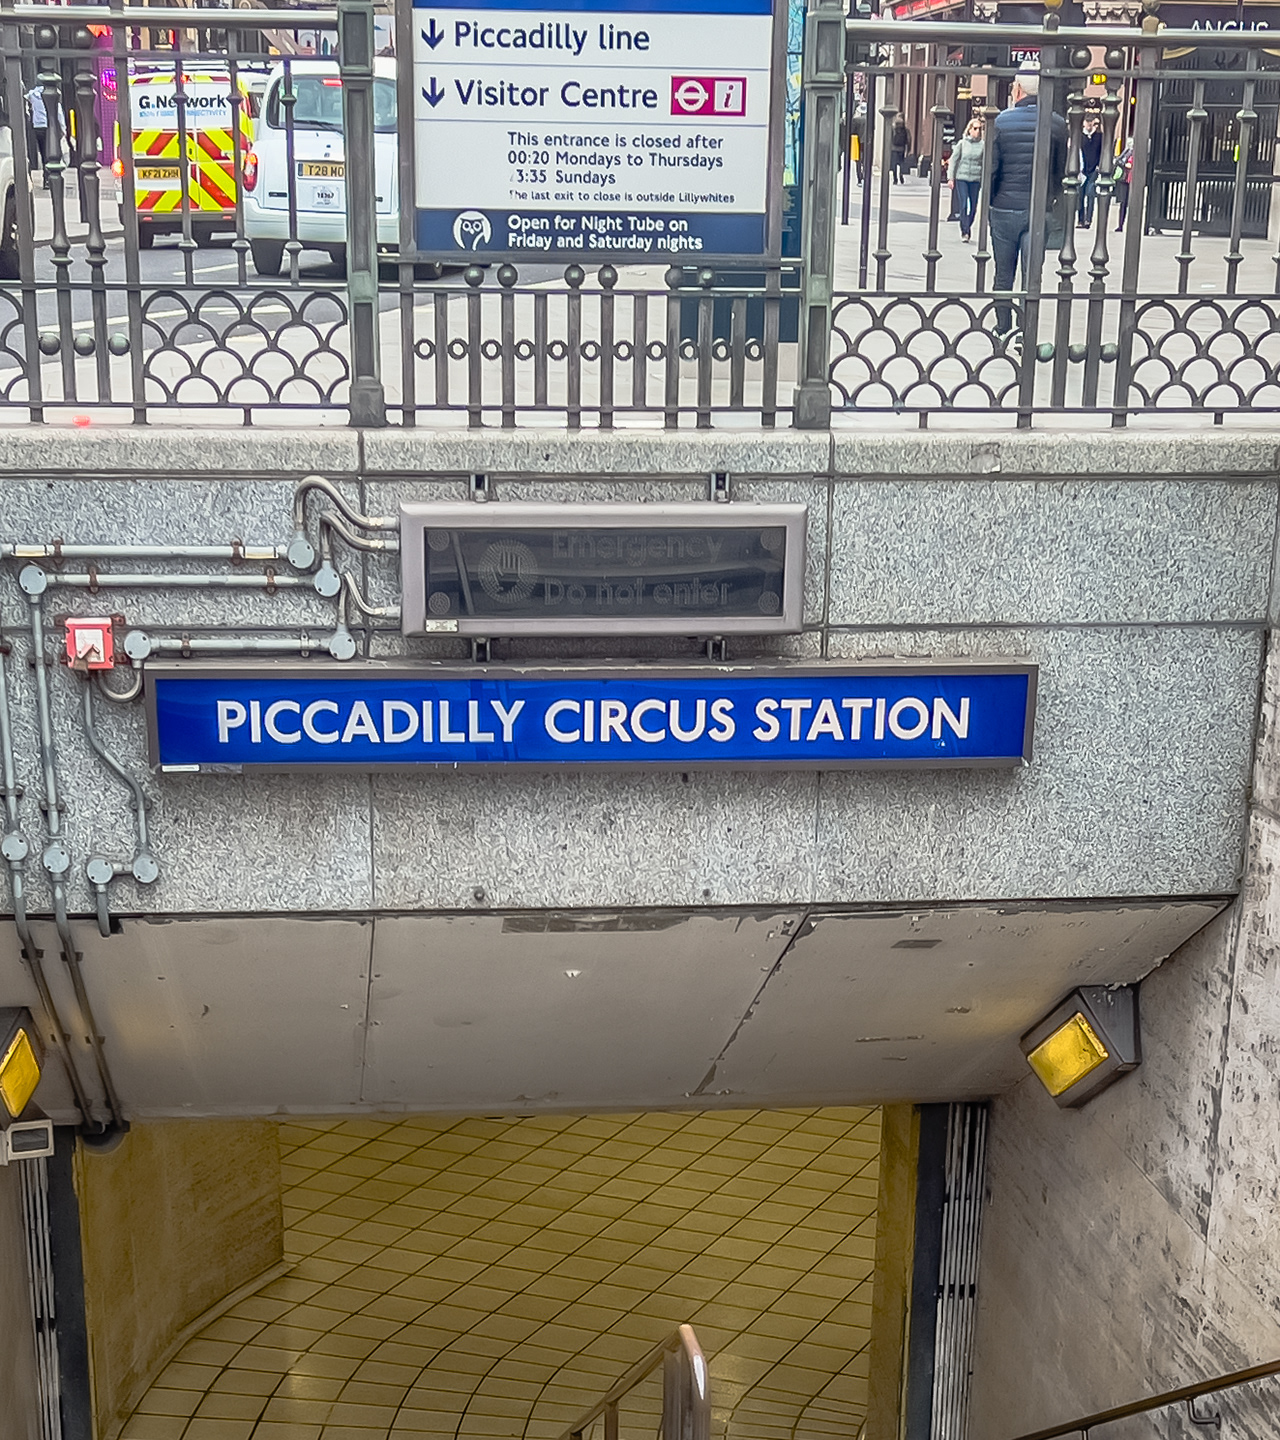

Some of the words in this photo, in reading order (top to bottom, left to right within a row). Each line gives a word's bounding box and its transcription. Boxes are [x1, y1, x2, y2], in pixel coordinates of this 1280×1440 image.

[454, 20, 588, 56] Piccadilly
[599, 23, 650, 50] line
[1010, 50, 1040, 62] TEAK
[138, 93, 227, 110] G.Nework
[454, 79, 549, 106] Visitor
[560, 80, 658, 108] Centre
[507, 131, 539, 146] This
[543, 133, 610, 147] entrance
[614, 133, 627, 147] is
[632, 134, 681, 148] closed
[686, 134, 724, 149] after
[507, 150, 550, 165] 00:20
[555, 151, 622, 169] Mondays
[626, 153, 644, 166] to
[648, 152, 724, 171] Thursdays
[307, 164, 328, 176] T28
[330, 165, 345, 178] MO
[509, 168, 547, 183] 3:35
[555, 169, 616, 187] Sundays
[531, 191, 551, 201] last
[554, 190, 574, 202] exit
[578, 191, 590, 201] to
[593, 190, 621, 202] close
[624, 191, 633, 202] is
[636, 191, 676, 203] outside
[678, 191, 736, 204] Lillywhites
[507, 214, 550, 232] Open
[554, 215, 576, 230] for
[581, 215, 623, 233] Night
[627, 216, 665, 232] Tube
[668, 219, 688, 232] on
[508, 232, 553, 251] Friday
[556, 233, 583, 248] and
[588, 233, 653, 252] Saturday
[657, 234, 704, 253] nights
[552, 531, 724, 566] Emergency
[544, 578, 587, 606] Do
[596, 576, 645, 605] not
[653, 576, 733, 605] enter
[217, 699, 526, 744] PICCADILLY
[543, 698, 736, 743] CIRCUS
[752, 697, 971, 742] STATION
